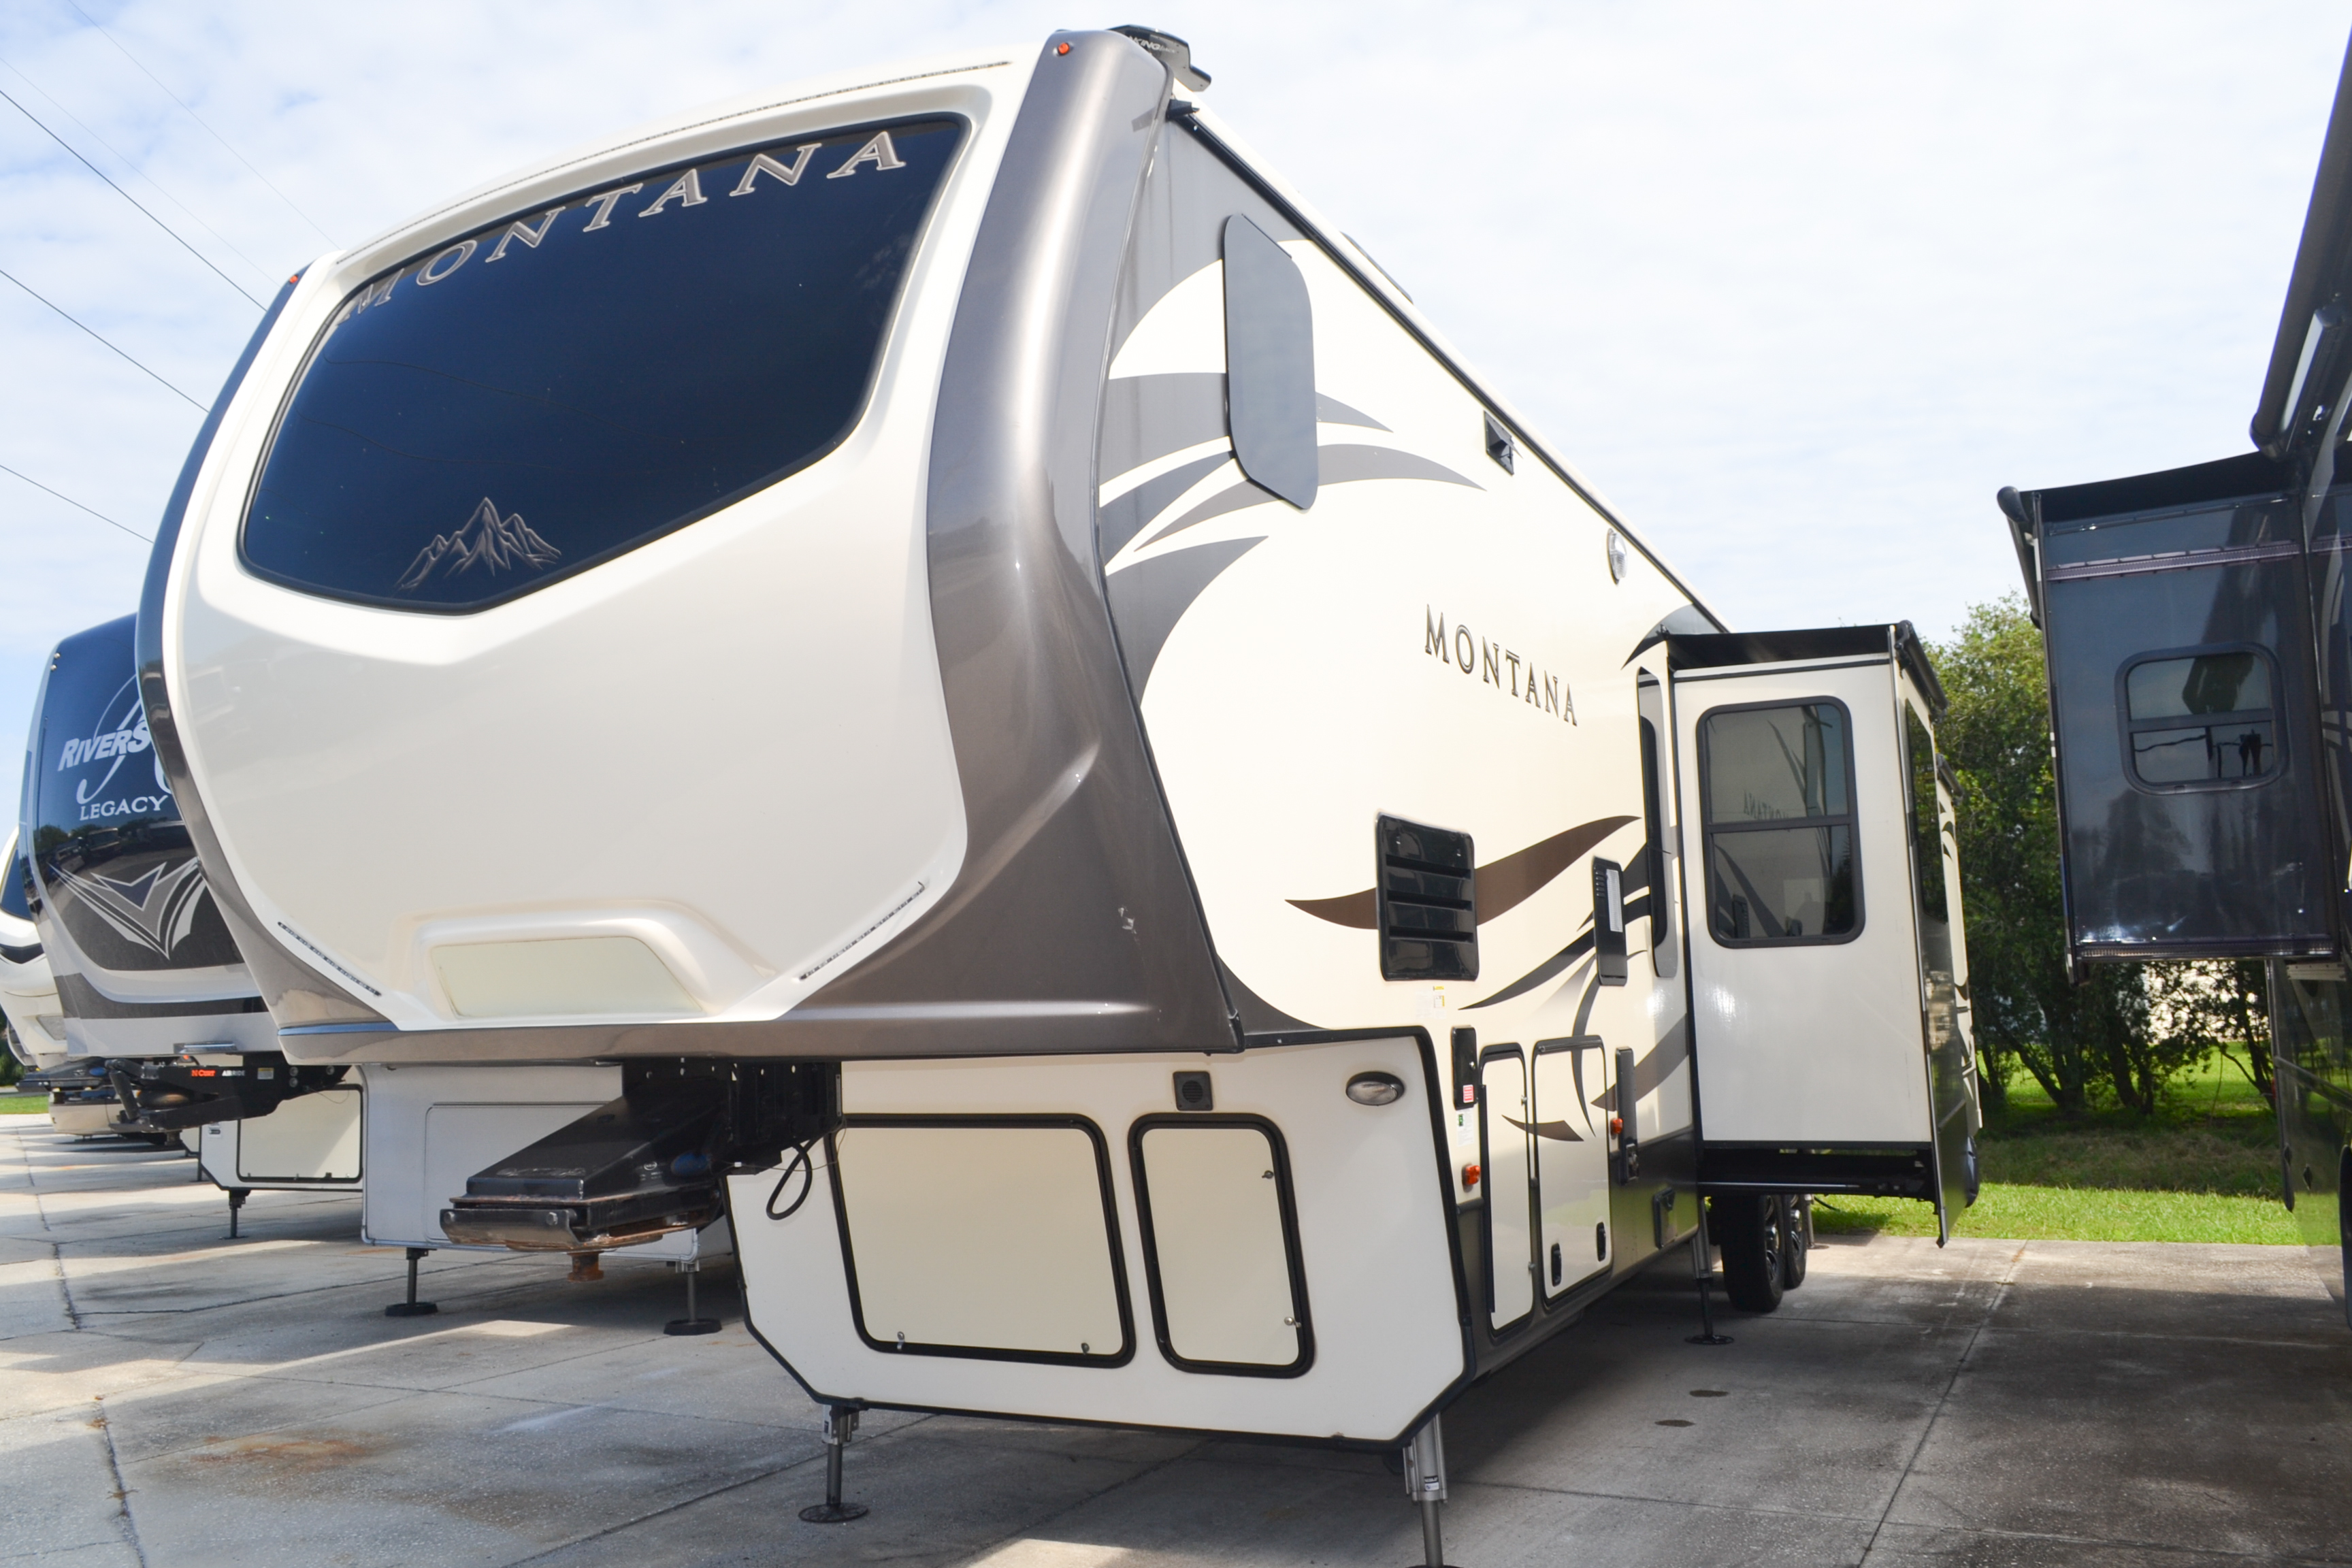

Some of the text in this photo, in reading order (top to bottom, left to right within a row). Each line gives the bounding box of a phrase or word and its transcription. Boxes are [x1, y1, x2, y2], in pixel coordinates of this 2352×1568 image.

[336, 131, 906, 326] MONTANA
[1425, 604, 1578, 727] MONTANA
[79, 794, 169, 821] LEGACY
